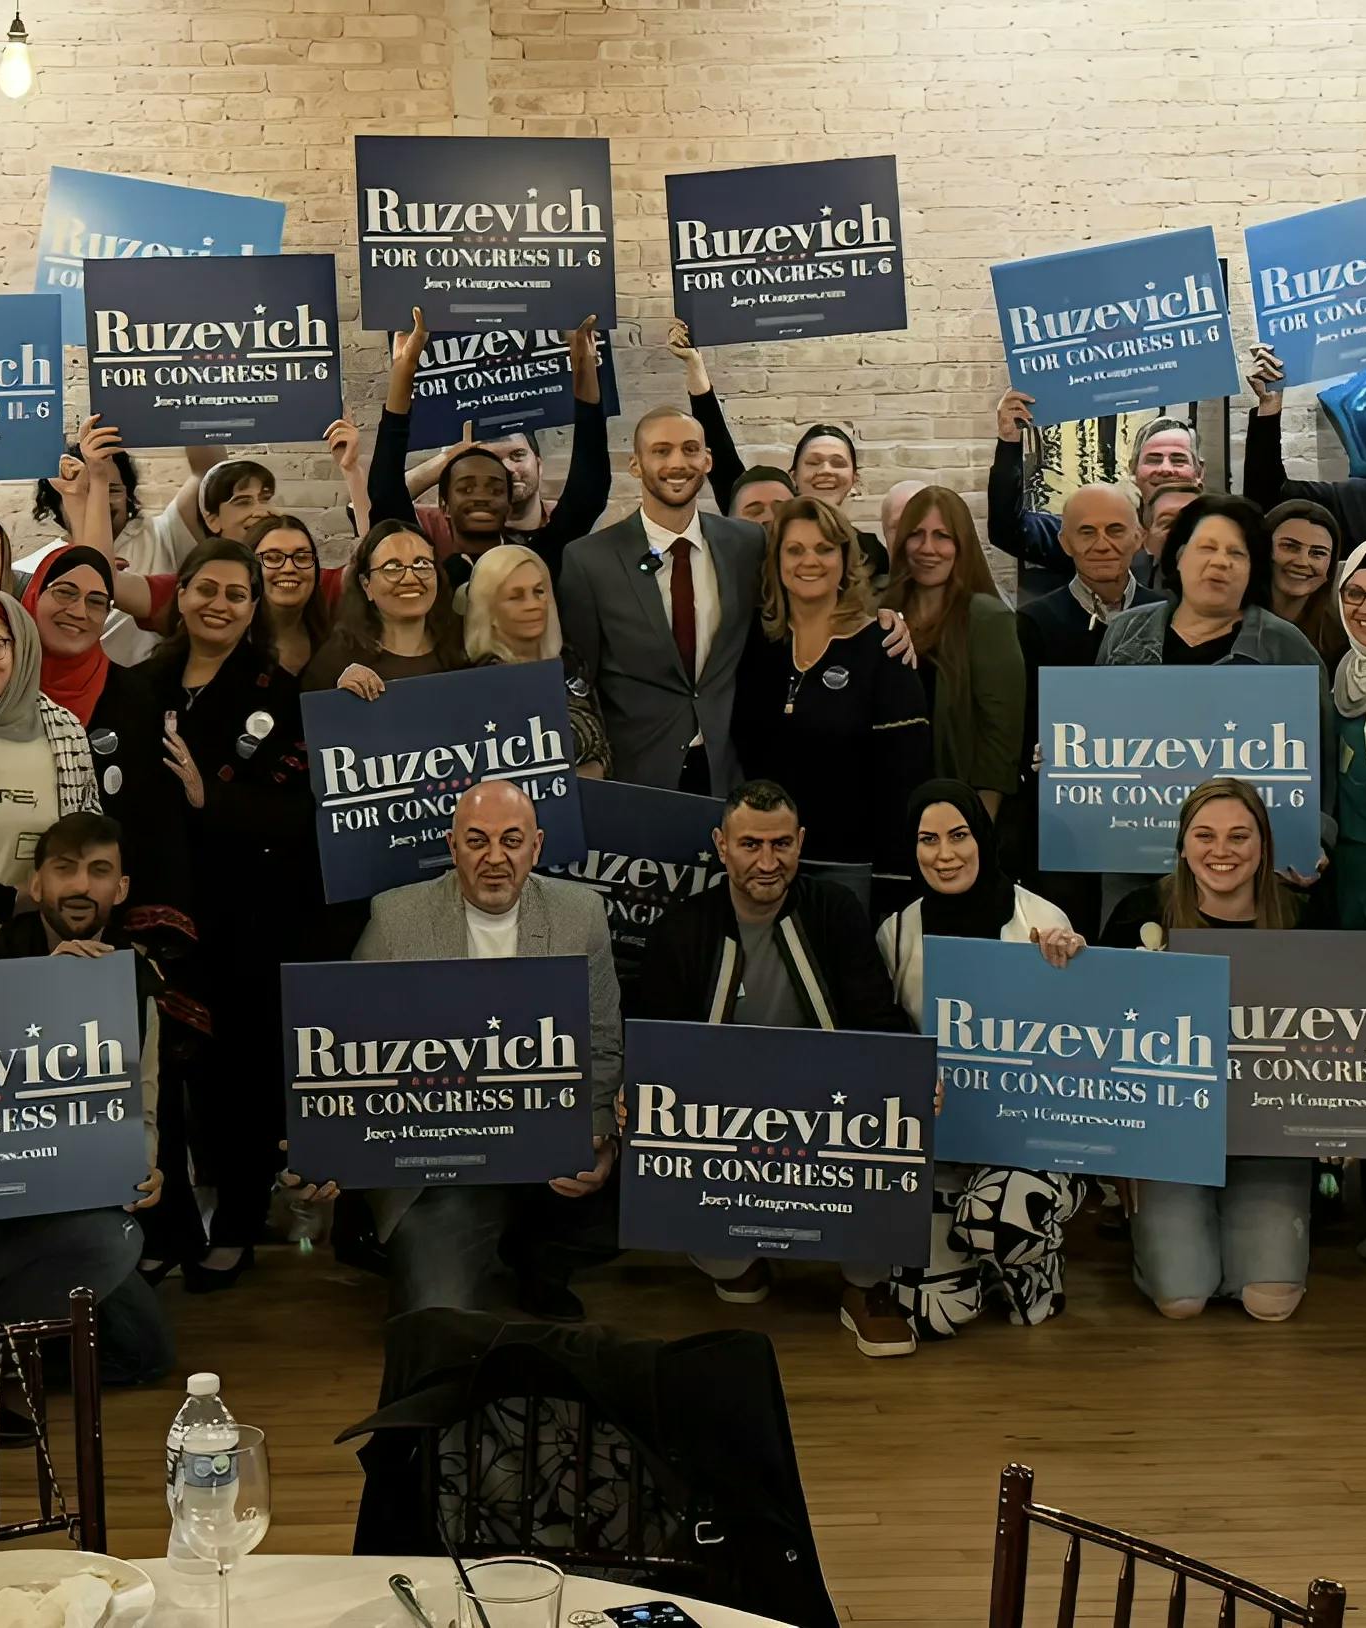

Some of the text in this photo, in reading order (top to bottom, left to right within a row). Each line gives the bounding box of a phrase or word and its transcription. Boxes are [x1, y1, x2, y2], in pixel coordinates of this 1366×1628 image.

[364, 188, 604, 235] Ruzevich
[675, 203, 894, 260] Ruzevich
[371, 247, 418, 268] FOR
[425, 246, 550, 267] CONGRESS
[683, 270, 725, 291] FOR
[731, 260, 845, 287] CONGRESS
[93, 304, 330, 354] Ruzevich
[1007, 274, 1218, 347] Ruzevich
[1268, 315, 1309, 336] FOR
[454, 357, 561, 391] CONGRESS
[1019, 352, 1059, 374] FOR
[1066, 334, 1175, 367] CONGRESS
[100, 366, 147, 388] FOR
[154, 363, 278, 386] CONGRESS
[318, 714, 565, 795] Ruzevich
[1051, 721, 1308, 771] Ruzevich
[1055, 784, 1103, 806] FOR
[331, 806, 379, 834] FOR
[292, 1016, 579, 1078] Ruzevich
[935, 997, 1215, 1069] Ruzevich
[302, 1087, 576, 1118] FOR CONGRESS IL-6
[940, 1066, 1210, 1111] FOR CONGRESS IL-6
[67, 1098, 126, 1126] IL-6
[634, 1083, 924, 1151] Ruzevich
[637, 1153, 919, 1193] FOR CONGRESS IL-6
